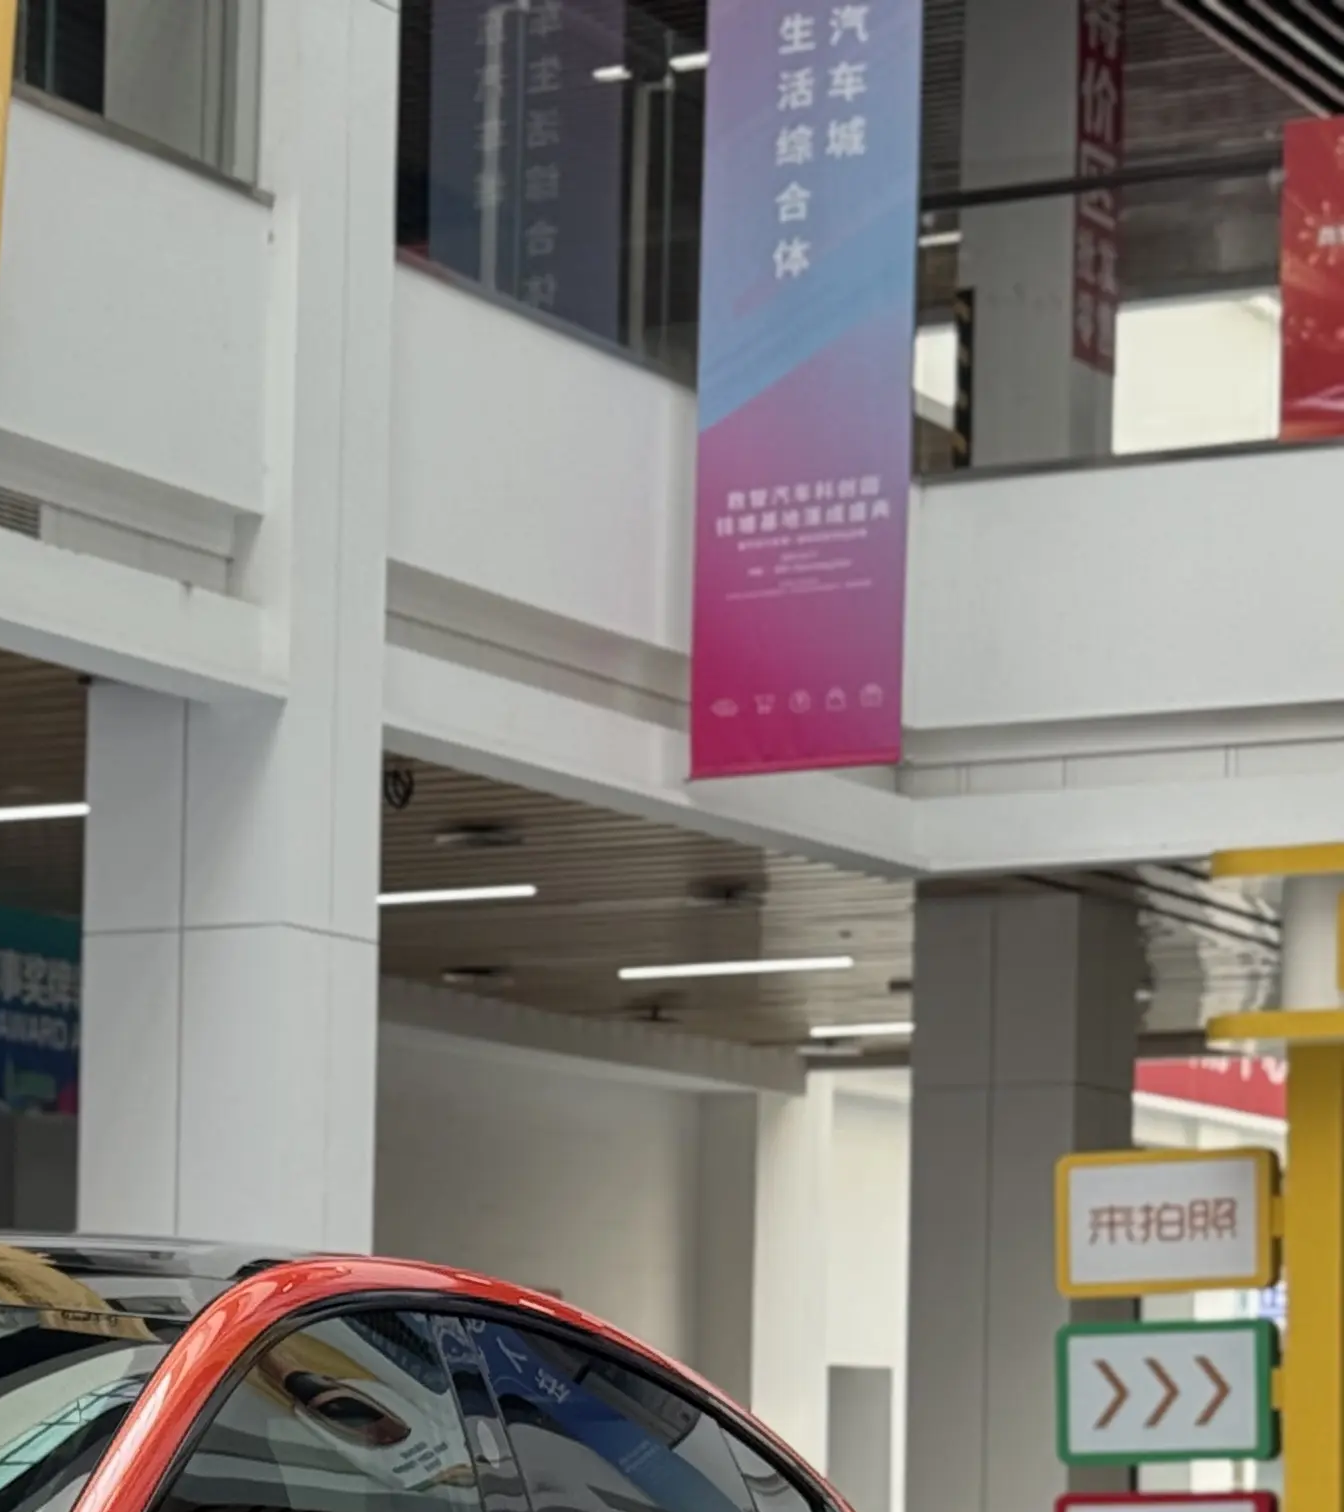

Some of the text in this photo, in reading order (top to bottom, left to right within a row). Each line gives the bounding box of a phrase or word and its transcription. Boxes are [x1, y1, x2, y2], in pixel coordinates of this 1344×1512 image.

[772, 12, 816, 280] 生活综合体
[825, 4, 870, 159] 汽车城
[1088, 1198, 1237, 1245] 来拍照
